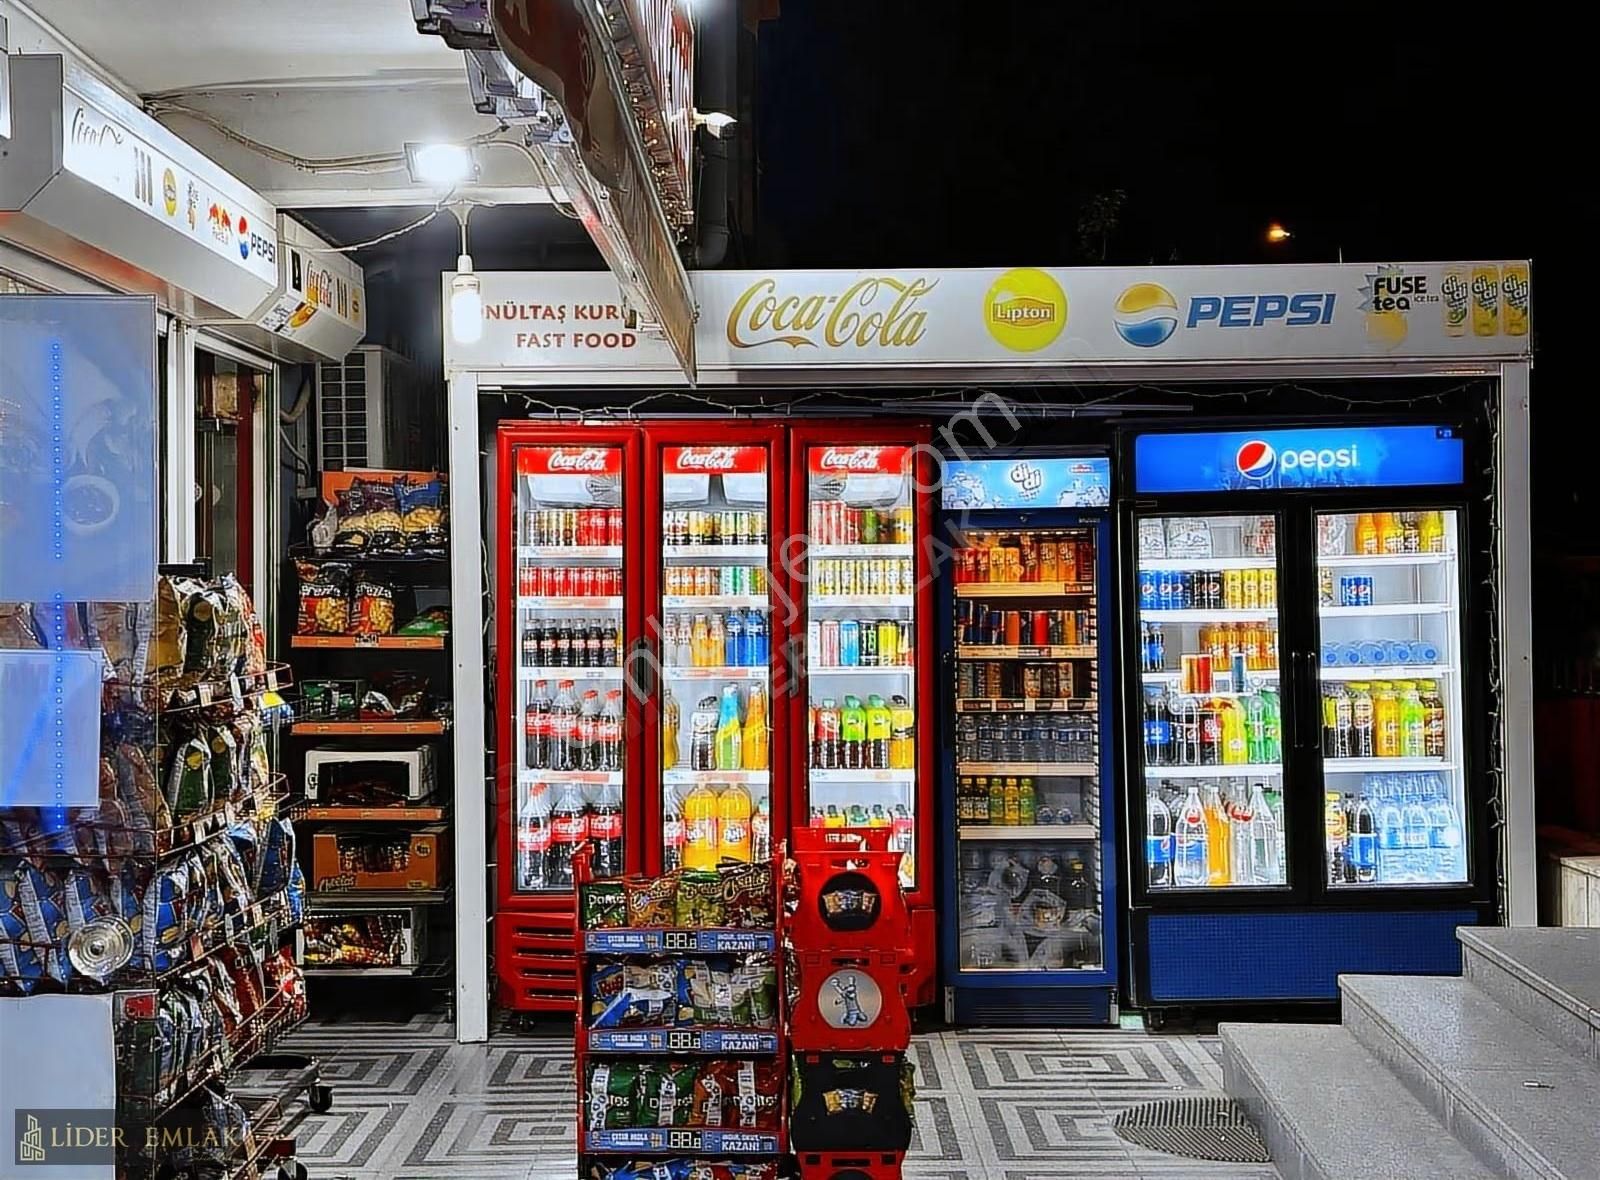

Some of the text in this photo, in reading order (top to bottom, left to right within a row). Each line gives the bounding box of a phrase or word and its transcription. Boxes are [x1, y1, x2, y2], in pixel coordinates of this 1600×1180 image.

[251, 233, 276, 264] PEPSI
[1373, 275, 1427, 295] FUSE
[483, 301, 566, 323] NÜLTAŞ
[726, 277, 940, 349] Coca-Cola
[996, 304, 1053, 321] Lipton
[1186, 293, 1337, 329] PEPSI
[1373, 296, 1411, 312] tea
[517, 332, 636, 348] FAST FOOD
[547, 449, 609, 471] Coca-Cola
[676, 448, 740, 470] Coca-Cola
[820, 448, 881, 470] Coca-Cola
[1280, 444, 1358, 472] pepsi
[721, 1141, 760, 1151] KAZAN!
